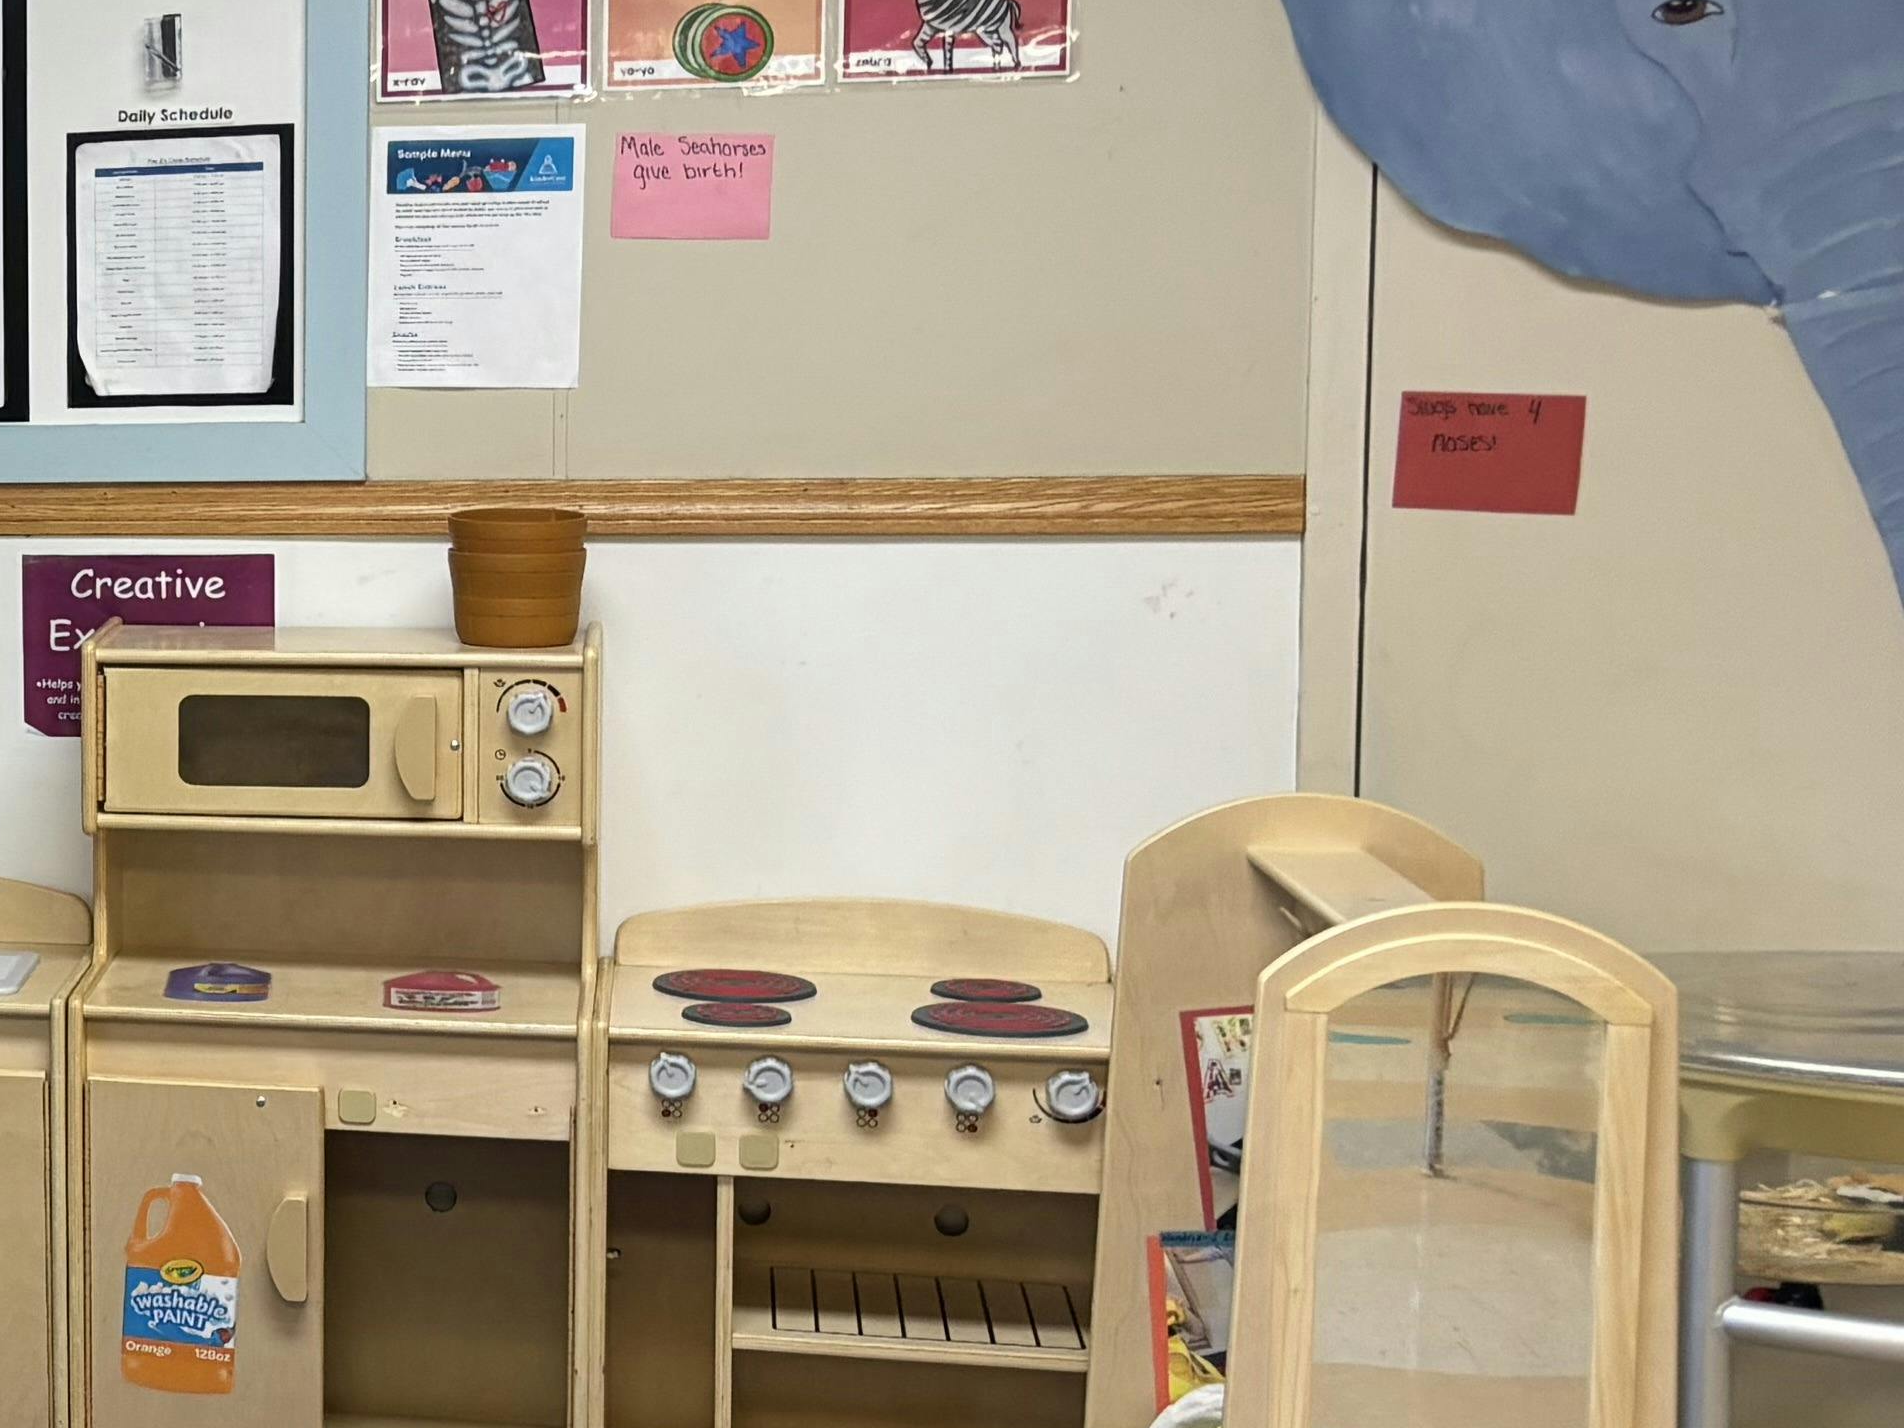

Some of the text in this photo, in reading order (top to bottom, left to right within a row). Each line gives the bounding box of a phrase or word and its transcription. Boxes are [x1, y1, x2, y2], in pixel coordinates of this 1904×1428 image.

[392, 74, 426, 90] x-ray
[117, 106, 234, 126] Daily Schedule
[396, 147, 471, 162] Sample Menu
[620, 134, 768, 158] Male Seahorses
[633, 161, 745, 190] give birth!
[1528, 399, 1543, 424] 4
[70, 567, 227, 602] Creative
[46, 693, 67, 705] and
[134, 1289, 229, 1319] washable
[152, 1308, 208, 1330] PAINT
[125, 1339, 231, 1363] Orange 128oz
